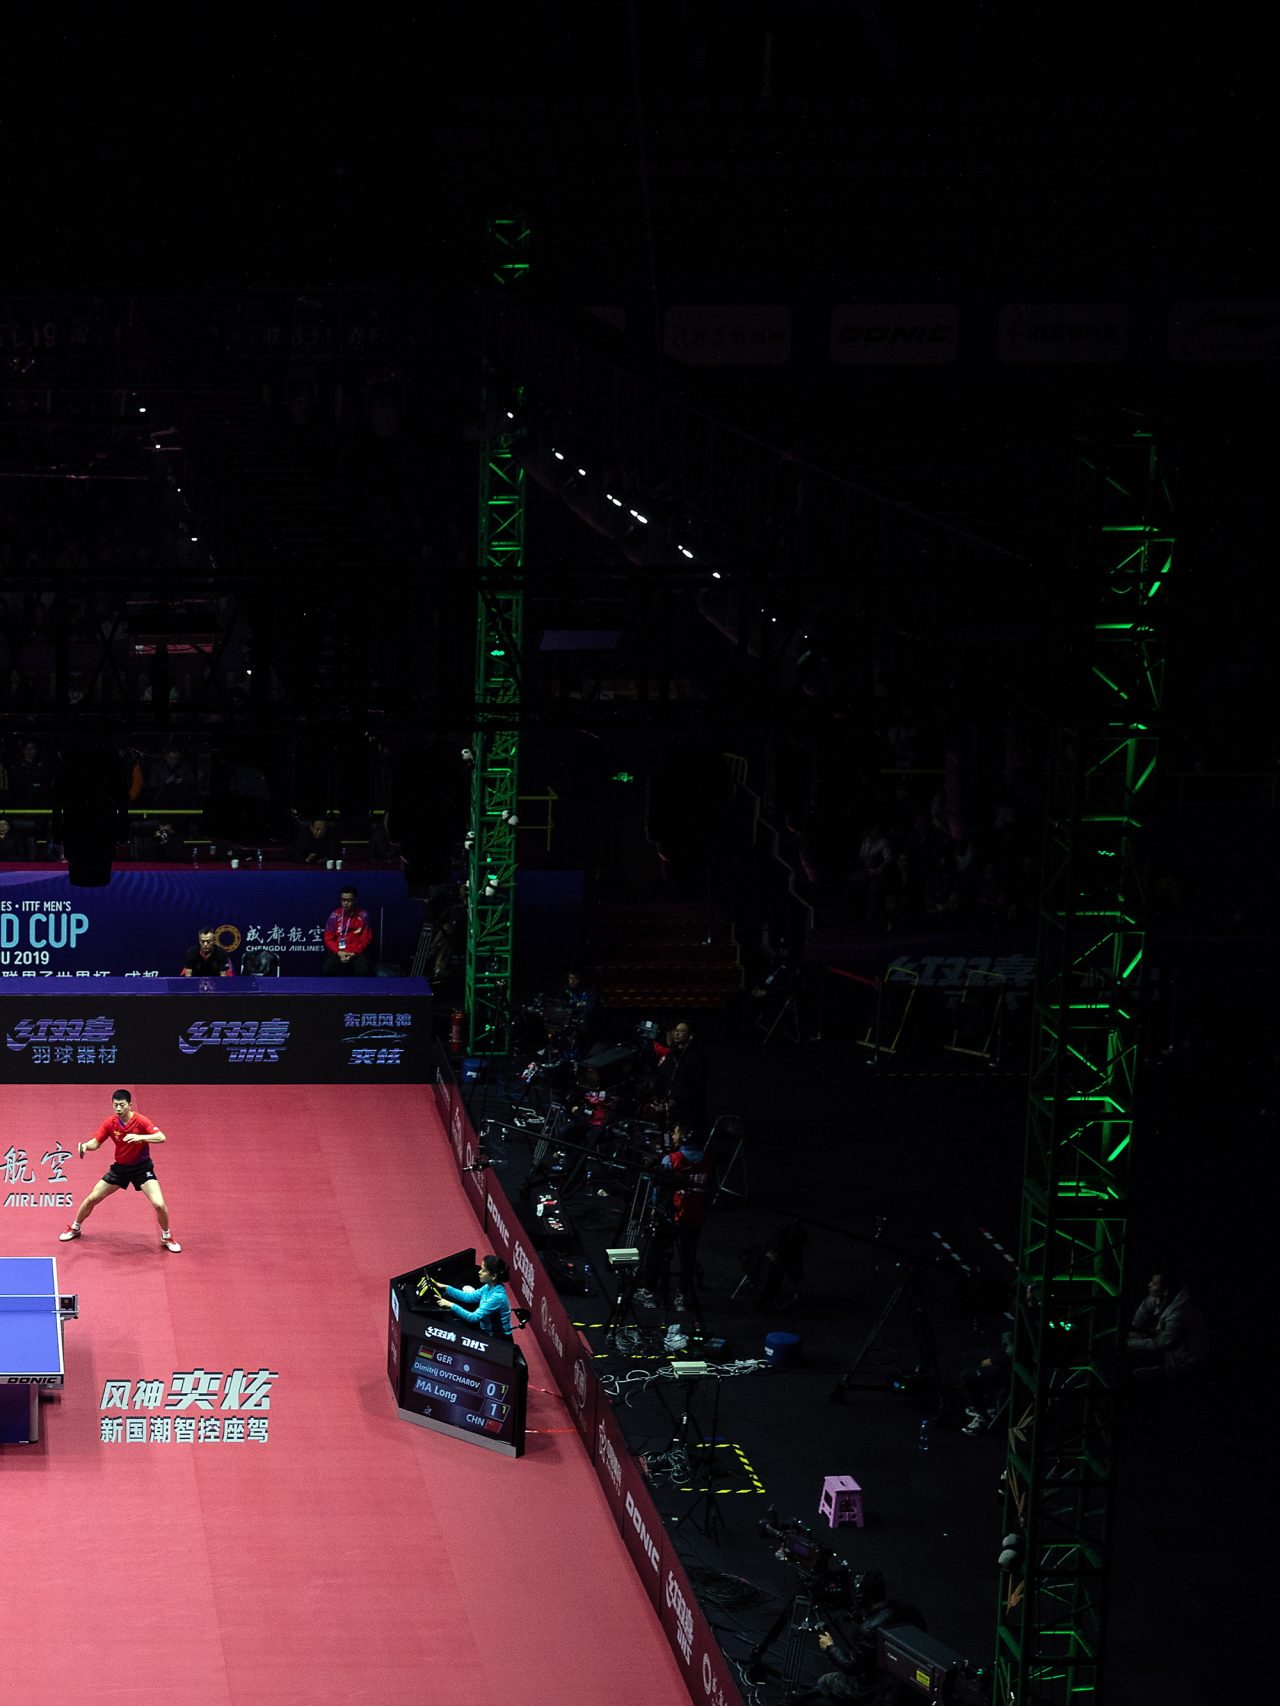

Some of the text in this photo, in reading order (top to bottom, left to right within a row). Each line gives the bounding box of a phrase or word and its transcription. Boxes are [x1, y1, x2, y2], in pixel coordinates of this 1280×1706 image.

[21, 901, 41, 912] ITTF
[43, 901, 72, 912] MEN'S
[28, 912, 90, 949] CUP
[245, 925, 325, 943] 成都航空
[14, 951, 50, 965] 2019
[32, 1045, 118, 1063] 羽球器材
[3, 1192, 73, 1207] AIRLINES
[487, 1193, 510, 1247] DONIC
[436, 1351, 453, 1365] GER
[415, 1380, 432, 1393] MA
[434, 1385, 458, 1402] Long
[439, 1369, 480, 1388] OVTCHAROV
[486, 1384, 496, 1396] 0
[466, 1413, 485, 1426] CHN
[100, 1416, 269, 1443] 新国潮智控座驾
[625, 1491, 660, 1572] DONIC
